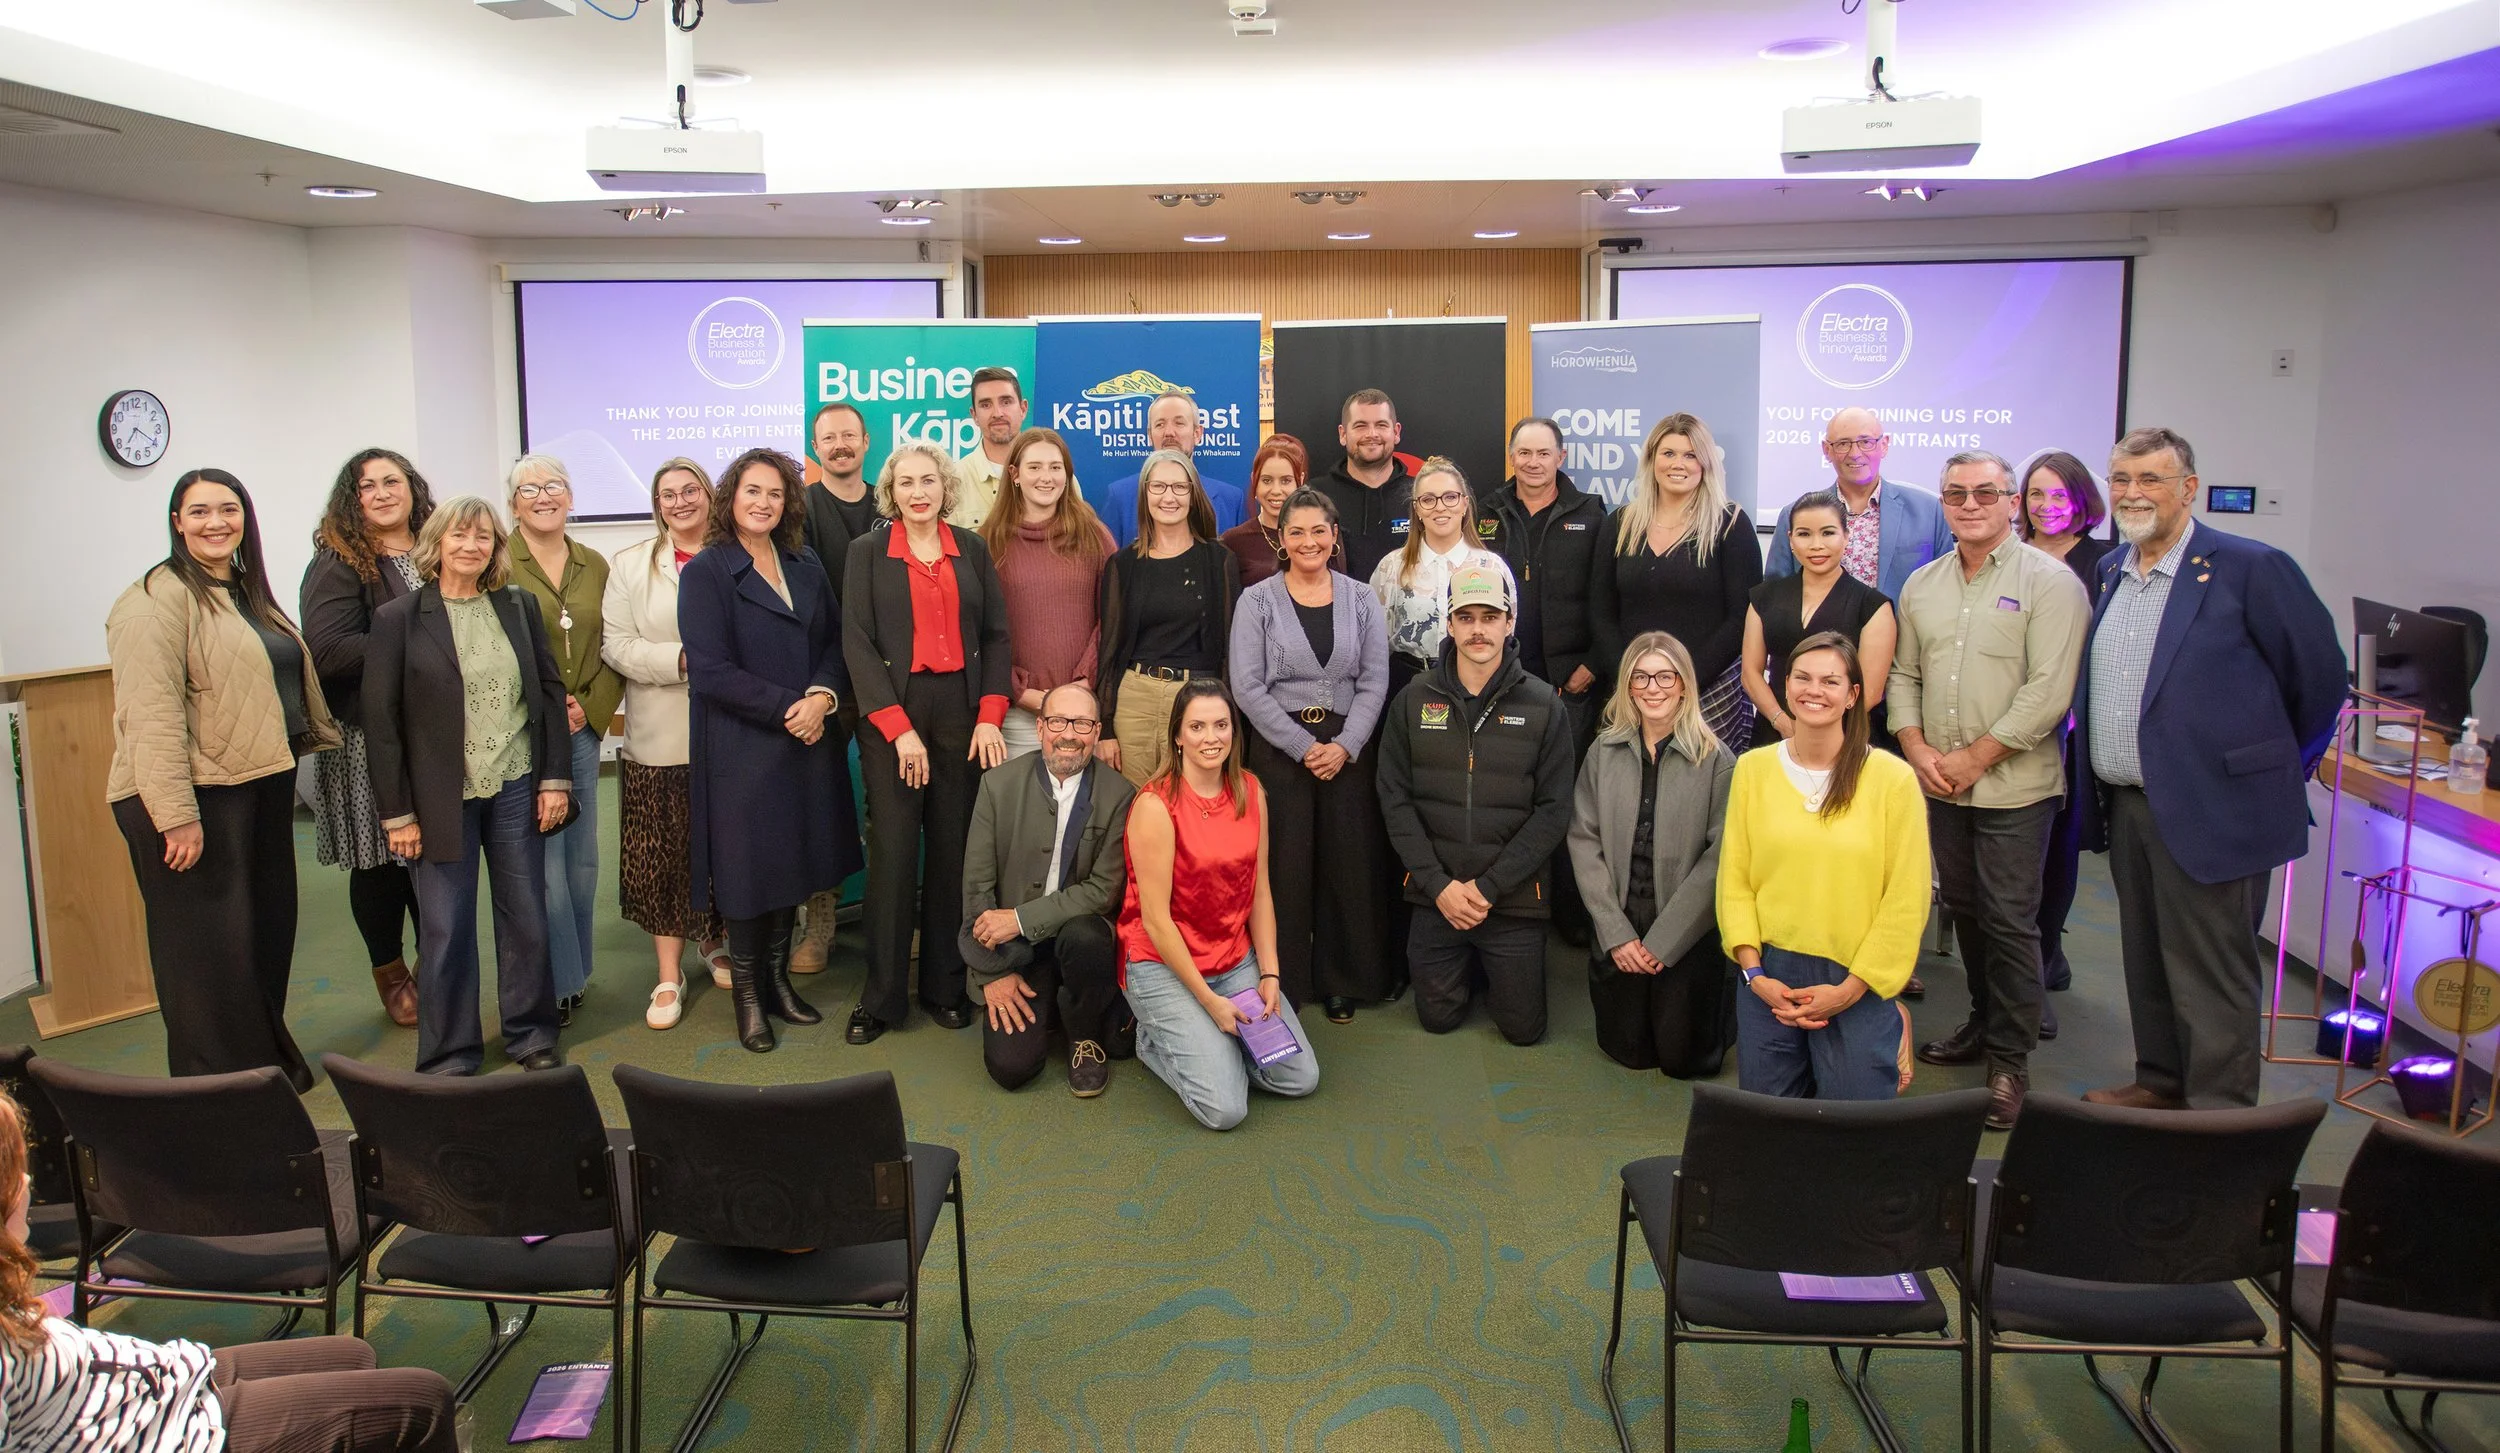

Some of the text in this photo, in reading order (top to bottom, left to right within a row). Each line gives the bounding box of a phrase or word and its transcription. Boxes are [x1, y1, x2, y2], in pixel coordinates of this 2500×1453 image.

[1866, 121, 1893, 129] EPSON
[1820, 313, 1889, 331] Electra
[709, 322, 765, 339] Electra
[1819, 331, 1888, 343] Business &
[708, 338, 766, 349] Business &
[1819, 343, 1887, 354] Innovation
[708, 349, 766, 359] Innovation
[1852, 354, 1888, 362] Awards
[1551, 355, 1637, 371] HOROWHENUA
[819, 356, 1018, 402] Busine
[120, 401, 129, 411] 11
[131, 397, 140, 408] 12
[113, 411, 123, 422] 10
[150, 410, 156, 421] 2
[606, 403, 806, 421] THANK YOU FOR JOINING
[1766, 406, 2013, 424] YOU FO INING US FOR
[1053, 402, 1240, 436] Kāpiti ast
[1552, 409, 1641, 436] COME
[111, 423, 117, 434] 9
[155, 423, 161, 434] 3
[632, 423, 805, 441] THE 2026 KĀPITI ENTR
[892, 410, 983, 463] Kāp
[1102, 433, 1241, 447] DISTRI UNCIL
[1766, 430, 1812, 445] 2026
[116, 438, 121, 449] 8
[124, 447, 130, 457] 7
[134, 449, 140, 460] 6
[144, 446, 150, 457] 5
[716, 446, 765, 460] EVE
[1102, 449, 1113, 457] Me
[1114, 449, 1129, 457] Huri
[1203, 449, 1241, 457] Whakamua
[1563, 443, 1625, 470] IND
